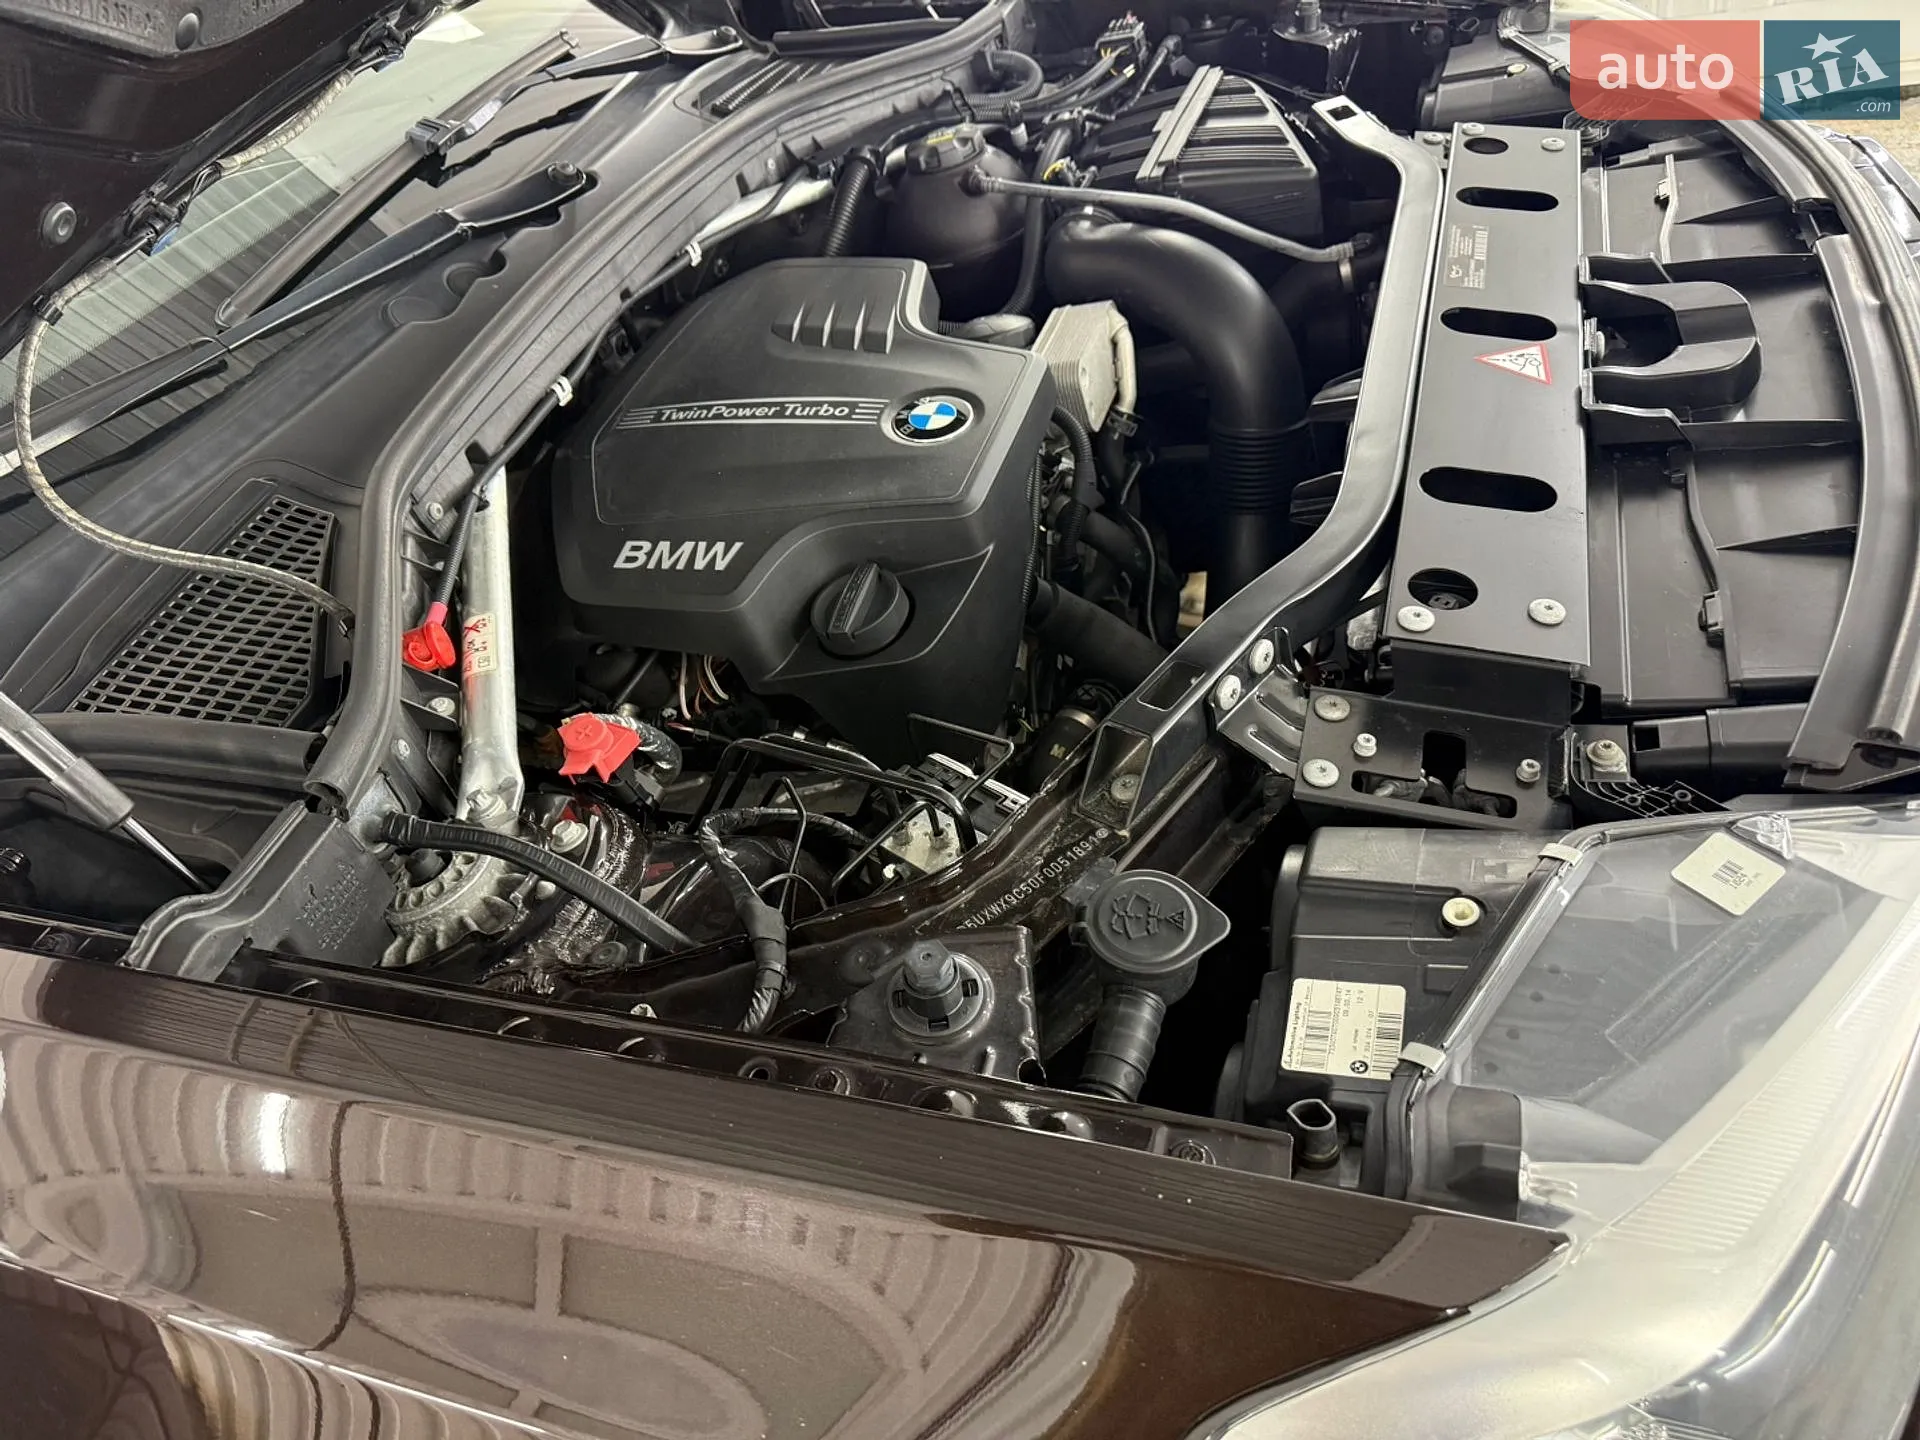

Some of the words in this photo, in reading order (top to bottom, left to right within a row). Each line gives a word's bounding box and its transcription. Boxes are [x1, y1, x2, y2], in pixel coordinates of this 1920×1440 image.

[659, 404, 780, 422] TwinPower
[784, 403, 850, 418] Turbo
[613, 540, 744, 571] BMW
[1291, 1001, 1303, 1025] Lighting
